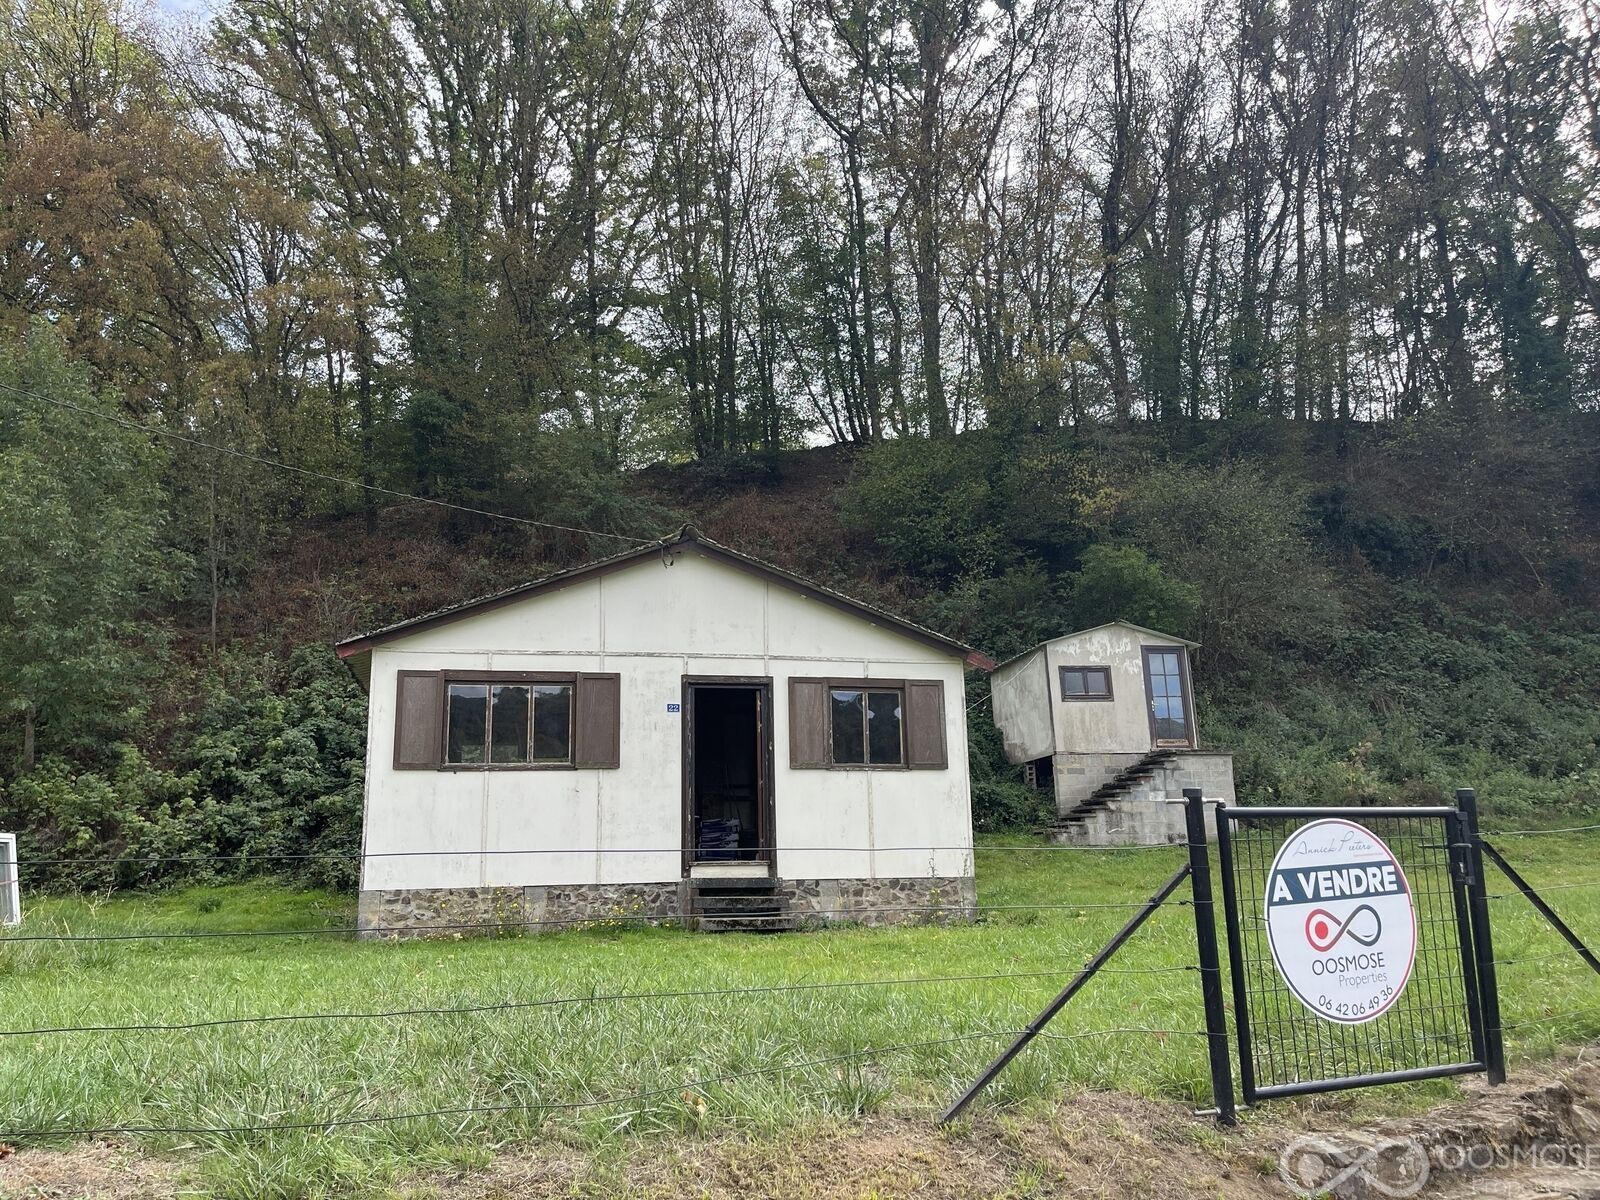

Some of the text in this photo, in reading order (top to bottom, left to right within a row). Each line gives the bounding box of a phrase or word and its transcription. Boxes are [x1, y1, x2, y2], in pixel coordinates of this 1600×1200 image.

[668, 704, 679, 712] 22
[1292, 838, 1337, 856] Annick
[1272, 865, 1398, 902] A VENDRE
[1312, 952, 1385, 976] OOSMOSE
[1339, 971, 1388, 988] Properties
[1318, 984, 1393, 1016] 06 42 06 49 36
